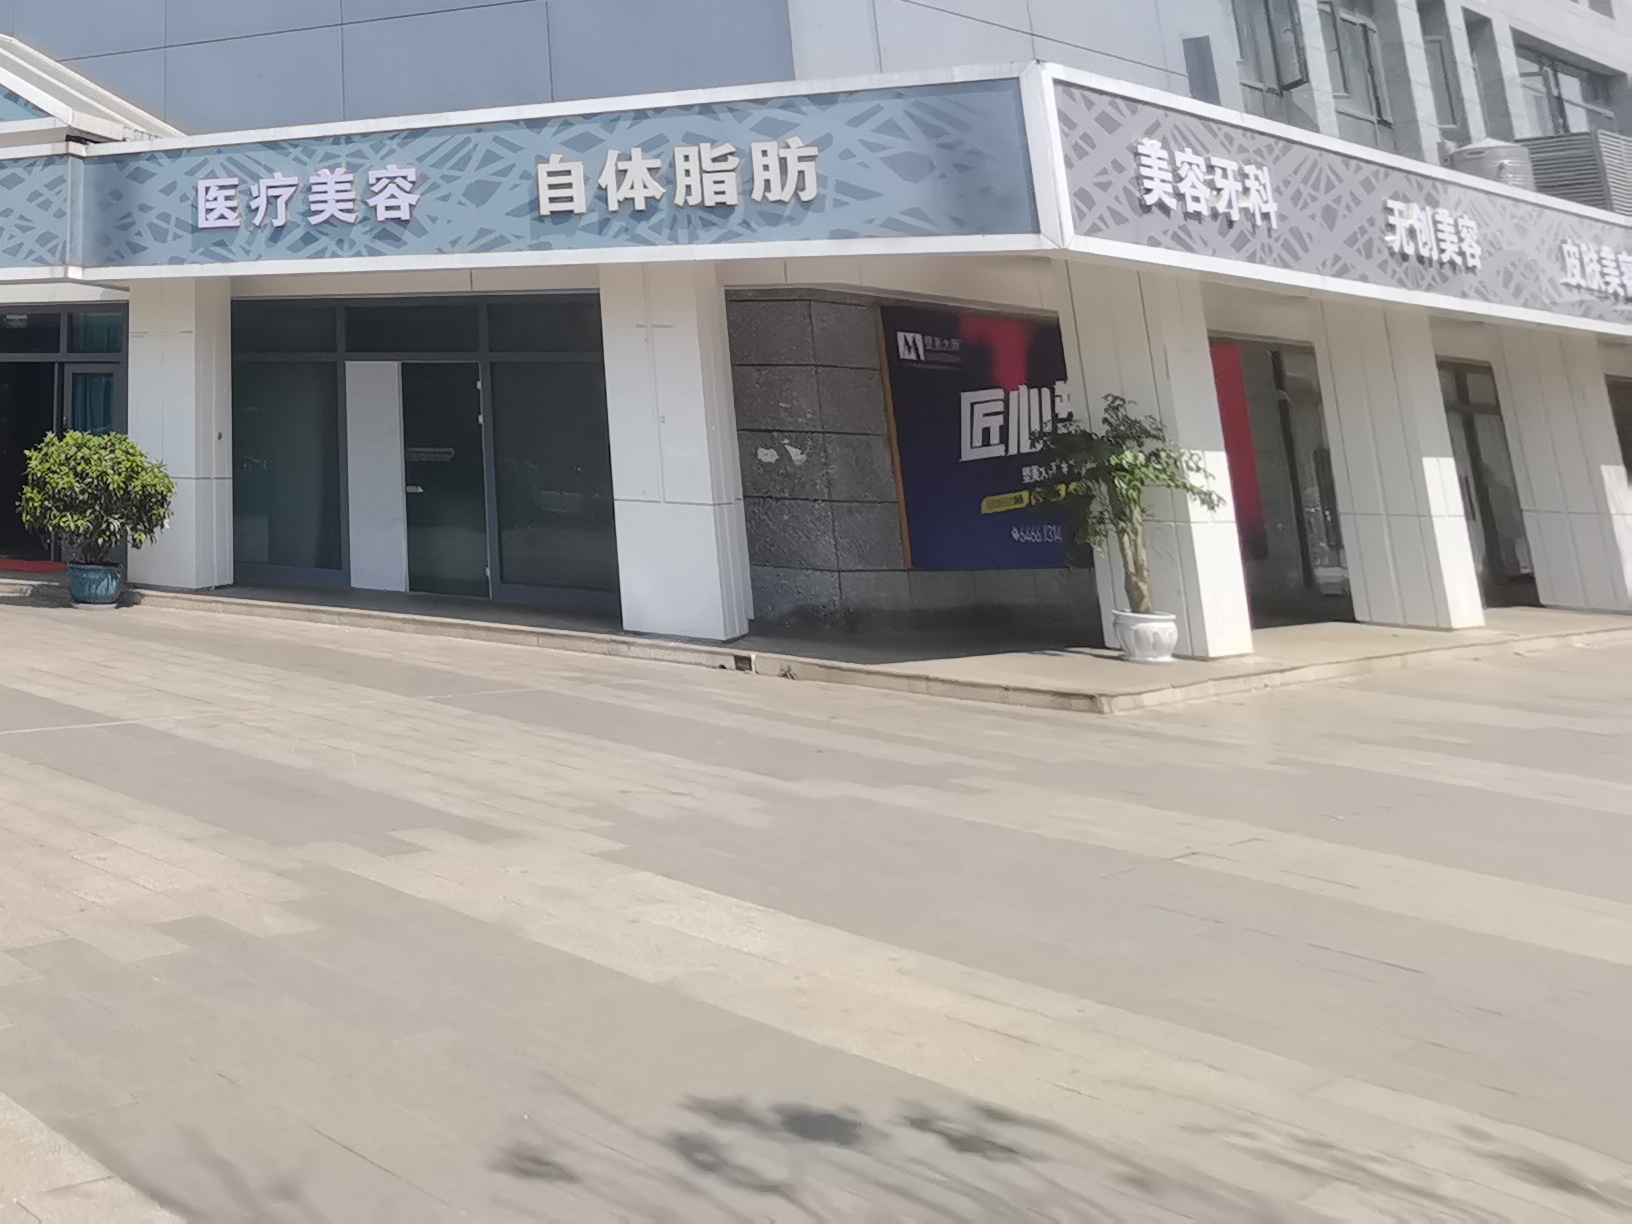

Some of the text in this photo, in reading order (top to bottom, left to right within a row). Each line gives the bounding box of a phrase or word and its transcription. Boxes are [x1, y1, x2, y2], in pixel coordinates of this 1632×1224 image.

[195, 163, 421, 230] 医疗美容
[535, 136, 819, 217] 自体脂肪
[1137, 137, 1278, 229] 美容牙科
[1384, 199, 1482, 269] 无创美容
[960, 380, 1069, 462] 匠心
